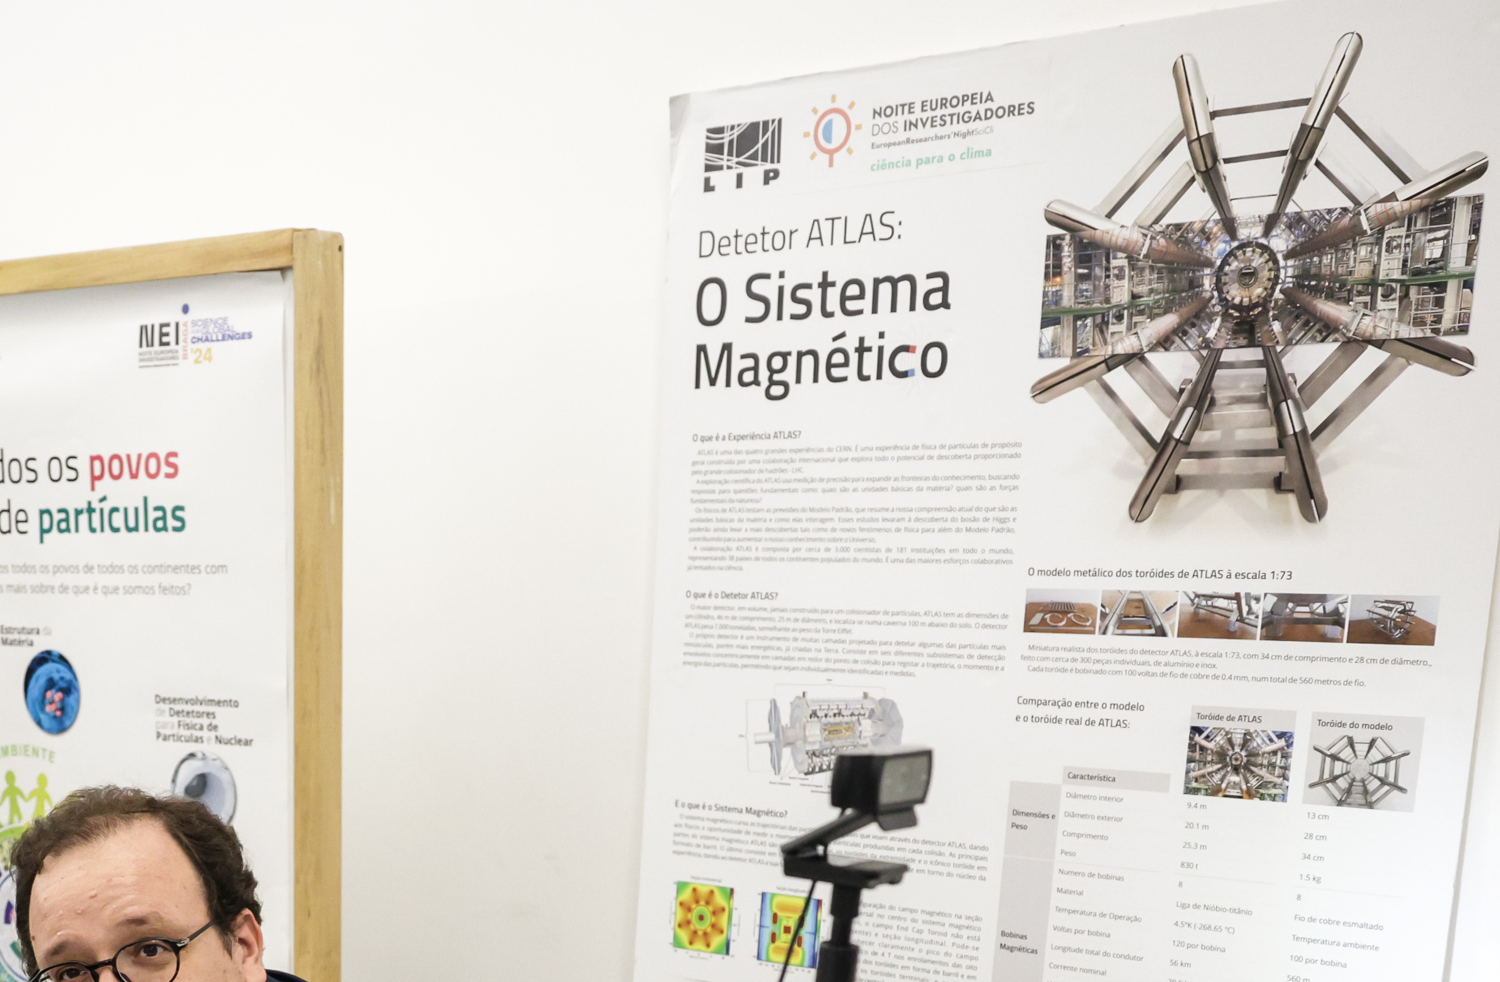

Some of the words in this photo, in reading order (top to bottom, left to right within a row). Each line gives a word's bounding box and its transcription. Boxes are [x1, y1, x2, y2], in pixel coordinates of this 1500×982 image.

[872, 104, 916, 120] NOITE
[920, 90, 995, 113] EUROPEIA
[872, 121, 899, 137] DOS
[903, 101, 1036, 132] INVESTIGADORES
[871, 157, 912, 171] ciência
[916, 154, 944, 169] para
[960, 146, 992, 160] clima
[704, 168, 781, 193] LIP
[698, 226, 799, 258] Detetor
[806, 211, 903, 248] ATLAS:
[696, 276, 728, 327] O
[744, 270, 951, 323] Sistema
[190, 331, 253, 344] CHALLENGES
[694, 331, 949, 401] Magnético
[699, 435, 714, 443] que
[727, 432, 771, 442] Experiência
[772, 430, 802, 439] ATLAS?
[47, 455, 79, 483] os
[88, 451, 180, 491] povos
[38, 496, 186, 544] partículas
[1037, 567, 1071, 577] modelo
[1073, 568, 1113, 577] metálico
[1115, 568, 1132, 578] dos
[1135, 568, 1175, 578] toróides
[1177, 569, 1189, 579] de
[1191, 569, 1223, 579] ATLAS
[1234, 570, 1266, 580] escala
[1270, 570, 1292, 580] 1:73
[692, 592, 707, 600] que
[720, 590, 749, 600] Detetor
[750, 591, 779, 600] ATLAS?
[155, 694, 240, 708] Desenvolvimento
[1016, 696, 1072, 709] Comparação
[1074, 700, 1099, 709] entre
[1109, 702, 1145, 711] modelo
[1030, 714, 1063, 724] toróide
[1065, 717, 1082, 726] real
[1084, 717, 1096, 726] de
[1098, 718, 1130, 728] ATLAS:
[1196, 712, 1224, 721] Toróide
[1226, 714, 1236, 722] de
[1237, 714, 1262, 723] ATLAS
[1317, 719, 1347, 728] Toróide
[1348, 721, 1359, 729] do
[1361, 722, 1393, 730] modelo
[1067, 772, 1116, 782] Característica
[1065, 791, 1098, 800] Diâmetro
[1098, 795, 1124, 803] interior
[1012, 809, 1050, 819] Dimensões
[1063, 810, 1096, 820] Diâmetro
[1010, 821, 1028, 830] Peso
[1184, 821, 1199, 829] 20.1
[1061, 830, 1109, 840] Comprimento
[1059, 848, 1077, 857] Peso
[1055, 906, 1097, 917] Temperatura
[1108, 912, 1142, 923] Operação
[1176, 900, 1190, 910] Liga
[1192, 902, 1201, 910] de
[1203, 904, 1252, 916] Nióbio-titânio
[1293, 914, 1306, 922] Fio
[1318, 918, 1341, 926] cobre
[1342, 921, 1384, 931] esmaltado
[1000, 930, 1028, 940] Bobinas
[999, 943, 1038, 954] Magnéticas
[1292, 934, 1340, 946] Temperatura
[1342, 942, 1379, 951] ambiente
